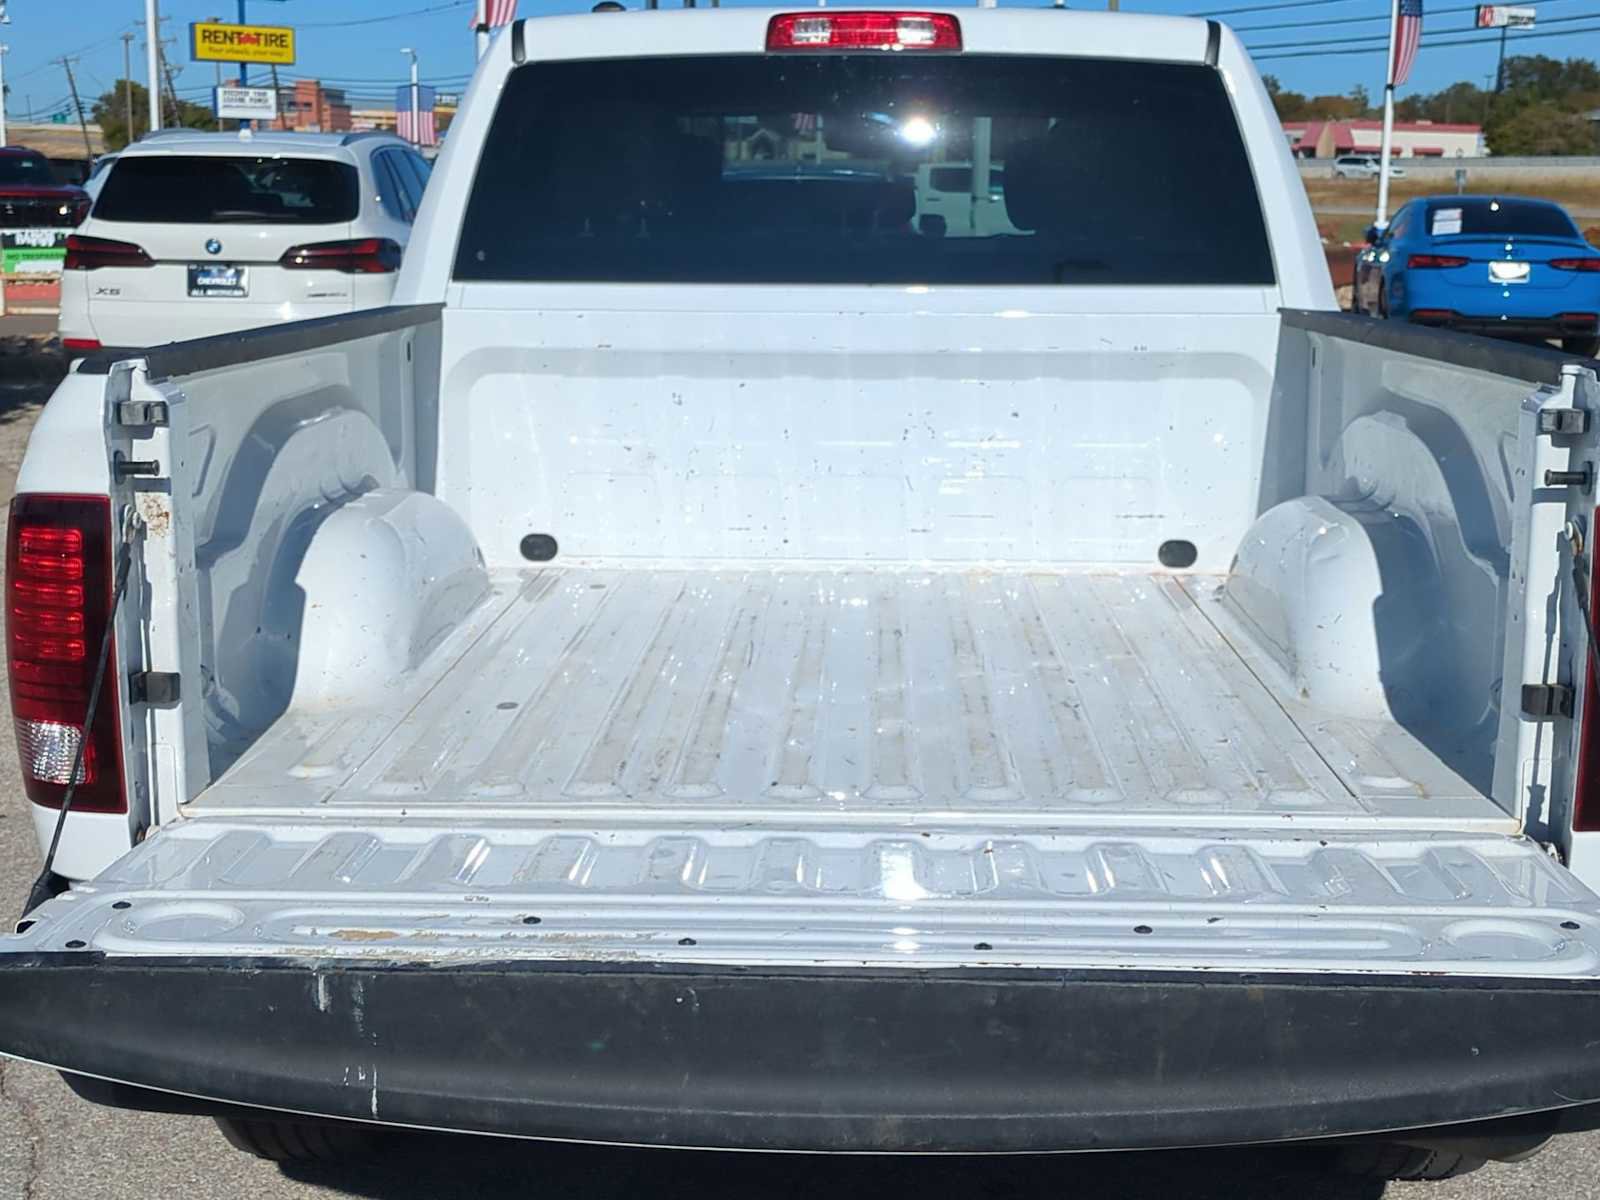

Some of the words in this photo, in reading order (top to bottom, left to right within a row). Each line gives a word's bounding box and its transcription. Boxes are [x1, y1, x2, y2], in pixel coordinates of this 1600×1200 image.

[202, 29, 241, 45] RENT
[255, 32, 289, 48] TIRE
[197, 276, 237, 286] CHEVROLET
